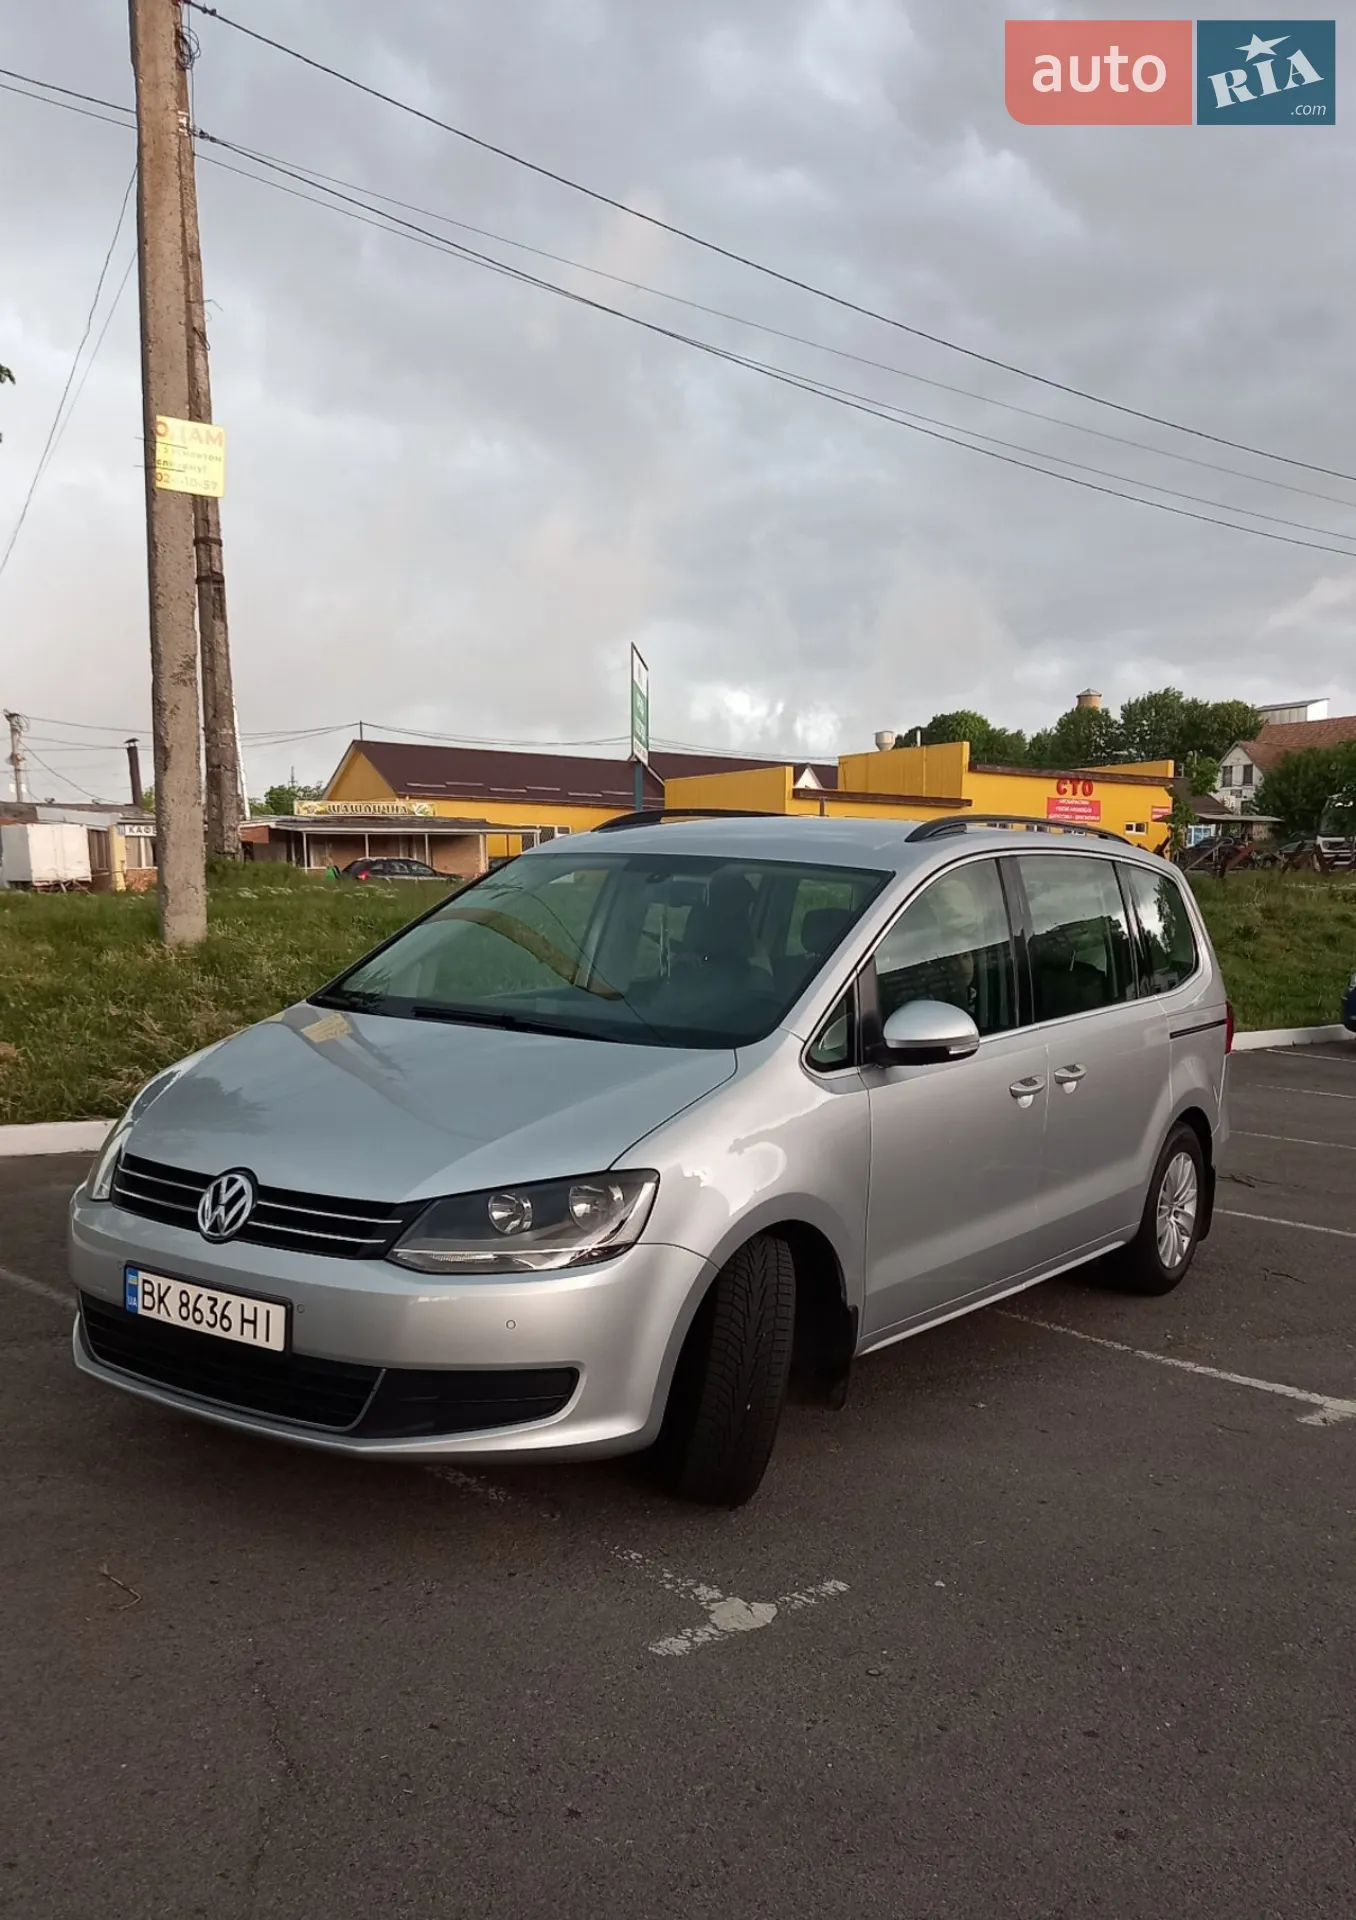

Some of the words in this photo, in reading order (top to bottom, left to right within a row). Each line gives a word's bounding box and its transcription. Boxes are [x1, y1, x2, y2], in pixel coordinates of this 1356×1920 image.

[1056, 779, 1094, 796] СТО
[142, 1278, 171, 1317] BK
[178, 1289, 232, 1333] 8636
[240, 1303, 270, 1343] HI
